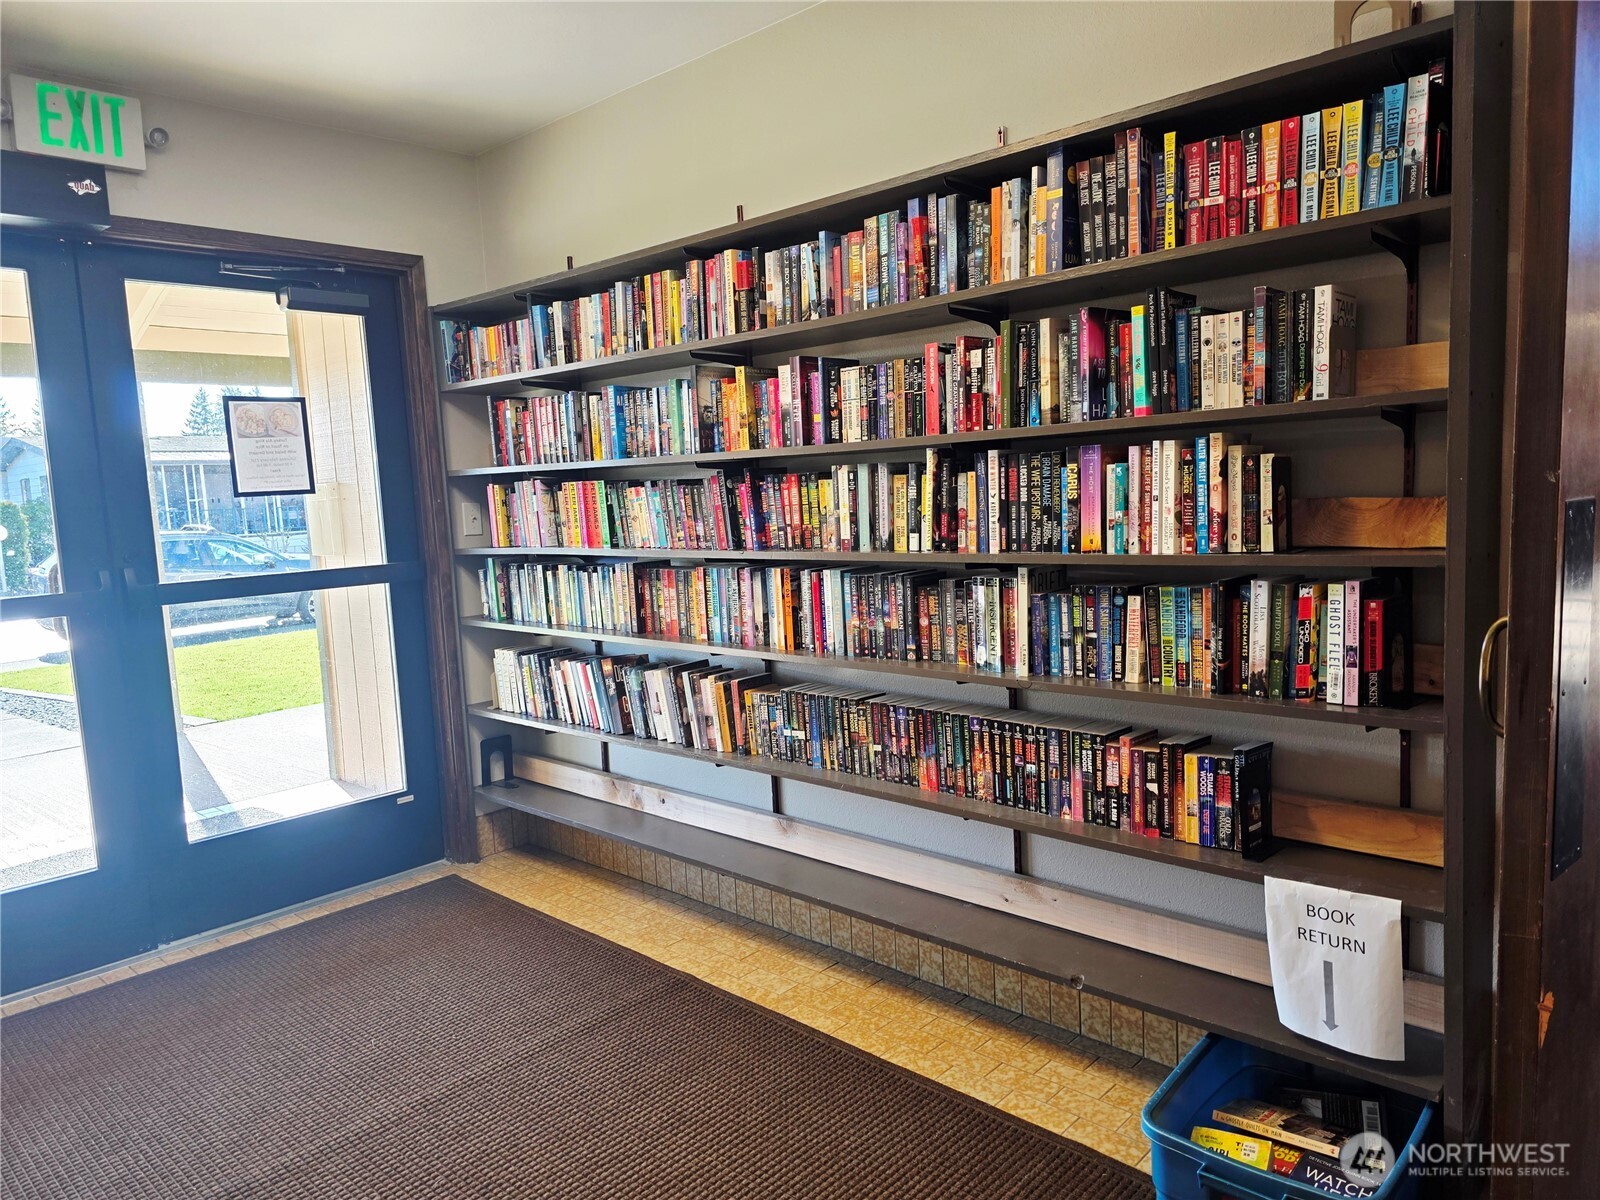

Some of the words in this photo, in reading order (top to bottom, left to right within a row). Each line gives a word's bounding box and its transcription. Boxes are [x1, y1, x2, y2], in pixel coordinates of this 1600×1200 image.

[36, 82, 125, 157] EXIT
[1376, 112, 1384, 122] LEE
[1387, 108, 1399, 122] LEE
[1417, 113, 1426, 138] LEE
[1326, 131, 1336, 144] LEE
[1348, 124, 1359, 140] LEE
[1386, 123, 1398, 146] CHILD
[1406, 108, 1416, 146] CHILD
[1130, 142, 1138, 160] LEE
[1286, 139, 1296, 152] LEE
[1306, 135, 1316, 148] LEE
[1348, 140, 1358, 162] CHILD
[1373, 134, 1382, 152] CHILD
[1166, 150, 1174, 160] LEE
[1246, 152, 1256, 164] LEE
[1266, 146, 1277, 160] LEE
[1305, 148, 1315, 170] CHILD
[1326, 145, 1336, 166] CHILD
[1106, 162, 1115, 178] FALSE
[1189, 165, 1199, 177] LEE
[1208, 162, 1218, 174] LEE
[1246, 164, 1256, 183] CHILD
[1266, 162, 1277, 181] CHILD
[1286, 153, 1296, 176] CHILD
[1156, 174, 1164, 186] LEE
[1190, 178, 1200, 198] CHILD
[1208, 175, 1218, 196] CHILD
[1347, 178, 1356, 192] PAST
[1384, 171, 1394, 190] MIDDLE
[1409, 165, 1418, 194] PERSONAL
[1106, 179, 1116, 206] EVIDENCE
[1156, 188, 1165, 208] CHILD
[1267, 196, 1275, 204] The
[1305, 188, 1314, 203] BLUE
[1325, 182, 1335, 218] PERSONAL
[1368, 177, 1379, 206] SENTINEL
[1384, 190, 1392, 202] NAME
[1346, 194, 1354, 212] TENSE
[880, 226, 888, 254] SANDRA
[881, 257, 889, 284] BROWN
[1278, 296, 1286, 320] TAMI
[1298, 300, 1306, 319] TAMI
[1316, 301, 1325, 324] TAMI
[1278, 322, 1286, 346] HOAG
[1316, 325, 1325, 354] HOAG
[987, 347, 995, 374] Griffin
[1278, 350, 1286, 368] THE
[970, 368, 978, 394] GRIFFIN
[1277, 370, 1287, 393] BOY
[792, 399, 800, 422] NEVER
[1198, 439, 1207, 459] WALTER
[1211, 436, 1220, 452] Jojo
[1031, 454, 1040, 467] THE
[1042, 458, 1050, 477] BRAIN
[1212, 455, 1220, 478] Moyes
[1031, 470, 1040, 486] WIFE
[1068, 464, 1078, 499] ICARUS
[1198, 462, 1207, 482] MOSLEY
[1042, 480, 1051, 506] DAMAGE
[1031, 489, 1040, 520] UPSTAIRS
[1212, 510, 1220, 532] before
[1086, 608, 1094, 630] SANDFORD
[1162, 598, 1172, 636] SANDFORD
[1176, 600, 1186, 638] SANDFORD
[1192, 598, 1202, 628] SANDFORD
[1330, 600, 1340, 636] GHOST
[989, 601, 998, 658] INSURGENT
[1100, 608, 1108, 643] SANDFORD
[1192, 640, 1202, 660] BLOODY
[1163, 645, 1173, 678] COUNTRY
[1369, 672, 1378, 703] BROKEN
[1218, 810, 1226, 838] PARADISE
[1306, 904, 1355, 926] BOOK
[1298, 927, 1366, 954] RETURN
[1224, 1116, 1244, 1125] GHOSTLY
[1246, 1122, 1260, 1131] QUILTS
[1271, 1130, 1282, 1138] MAIN
[1308, 1155, 1332, 1167] DETECTIVE
[1306, 1166, 1373, 1198] WATCH
